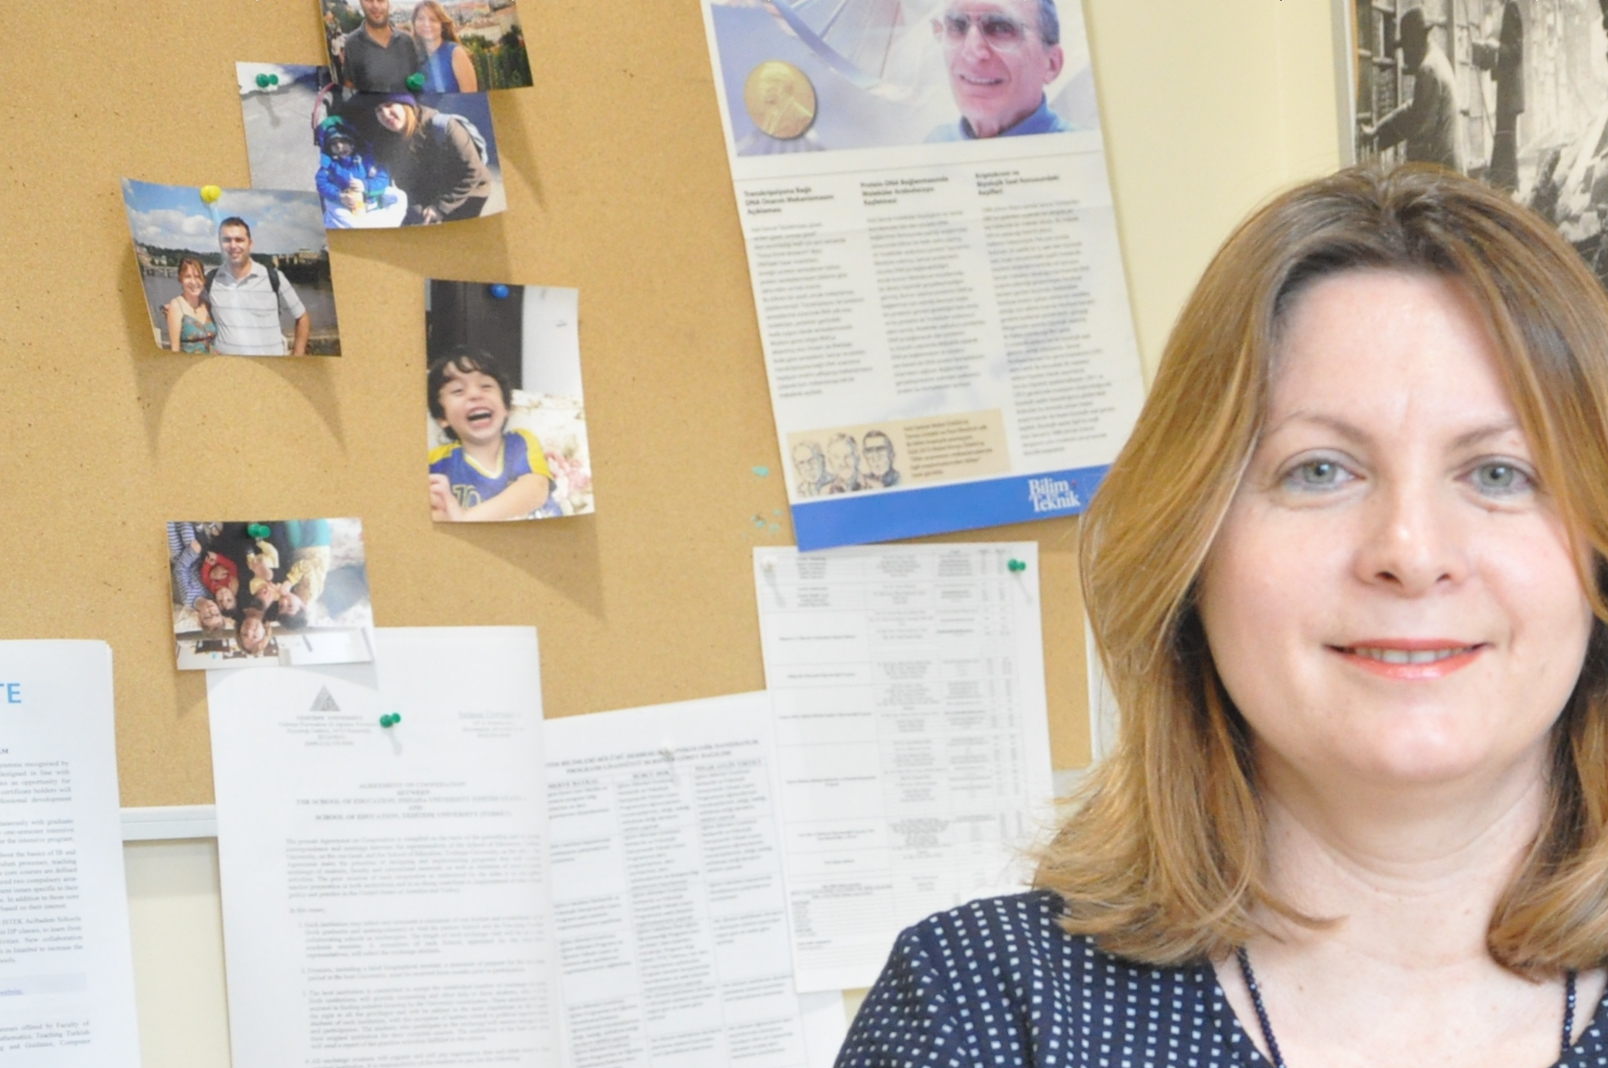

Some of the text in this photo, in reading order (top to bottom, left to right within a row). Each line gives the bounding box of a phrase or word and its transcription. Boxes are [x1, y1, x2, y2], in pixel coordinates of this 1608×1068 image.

[1028, 477, 1070, 496] Bilim
[1028, 490, 1081, 512] Teknik
[0, 682, 22, 704] E
